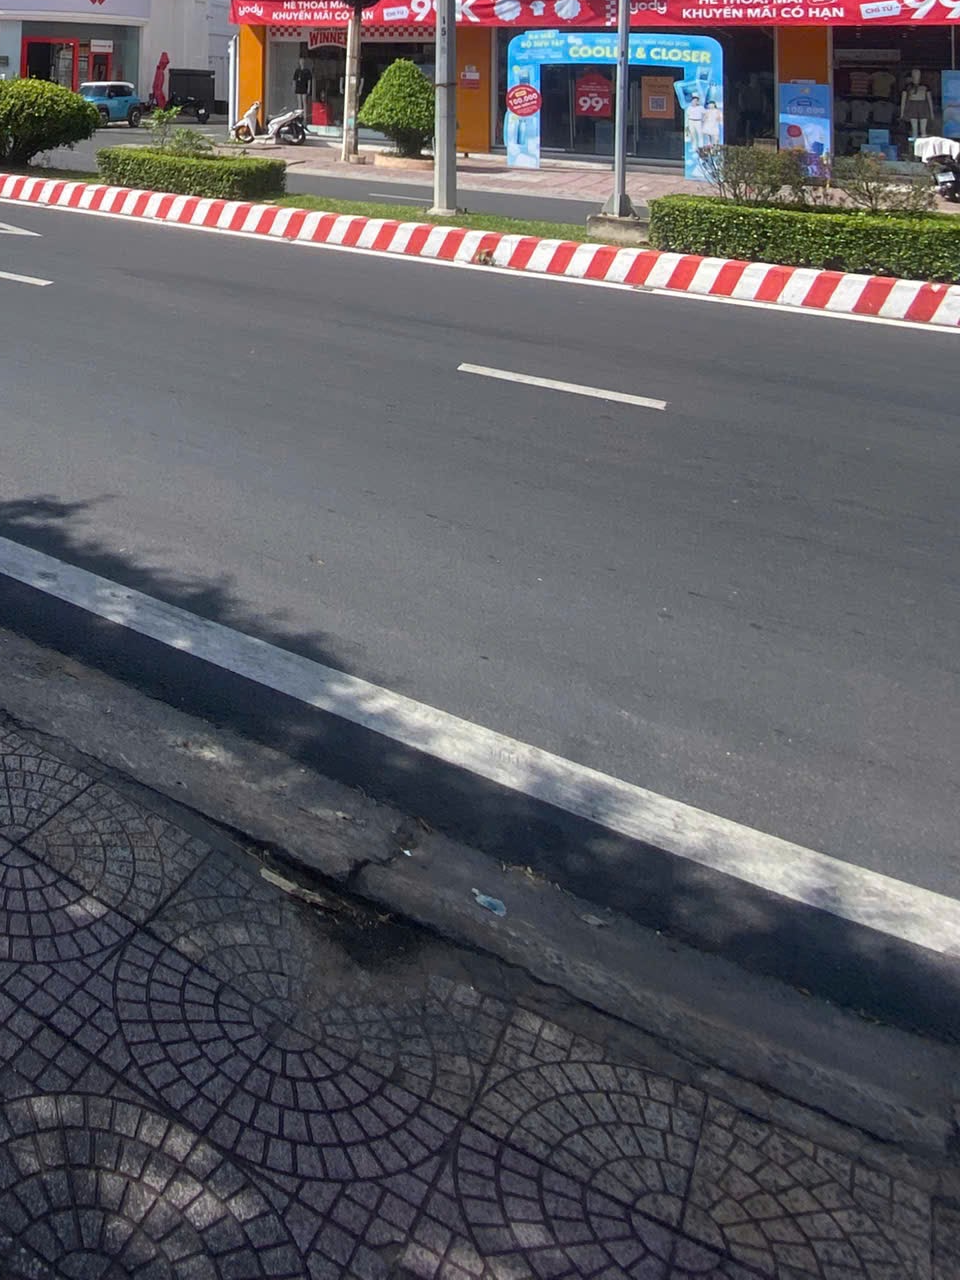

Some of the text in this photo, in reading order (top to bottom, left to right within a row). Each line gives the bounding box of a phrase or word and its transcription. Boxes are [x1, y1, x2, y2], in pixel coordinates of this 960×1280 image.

[239, 4, 264, 17] yody
[630, 0, 667, 15] yody
[682, 4, 845, 20] KHUYẾN MÃI CÓ HẠN
[309, 31, 348, 45] WINNE
[569, 46, 631, 59] COOLE
[635, 46, 647, 60] &
[650, 47, 711, 64] CLOSER
